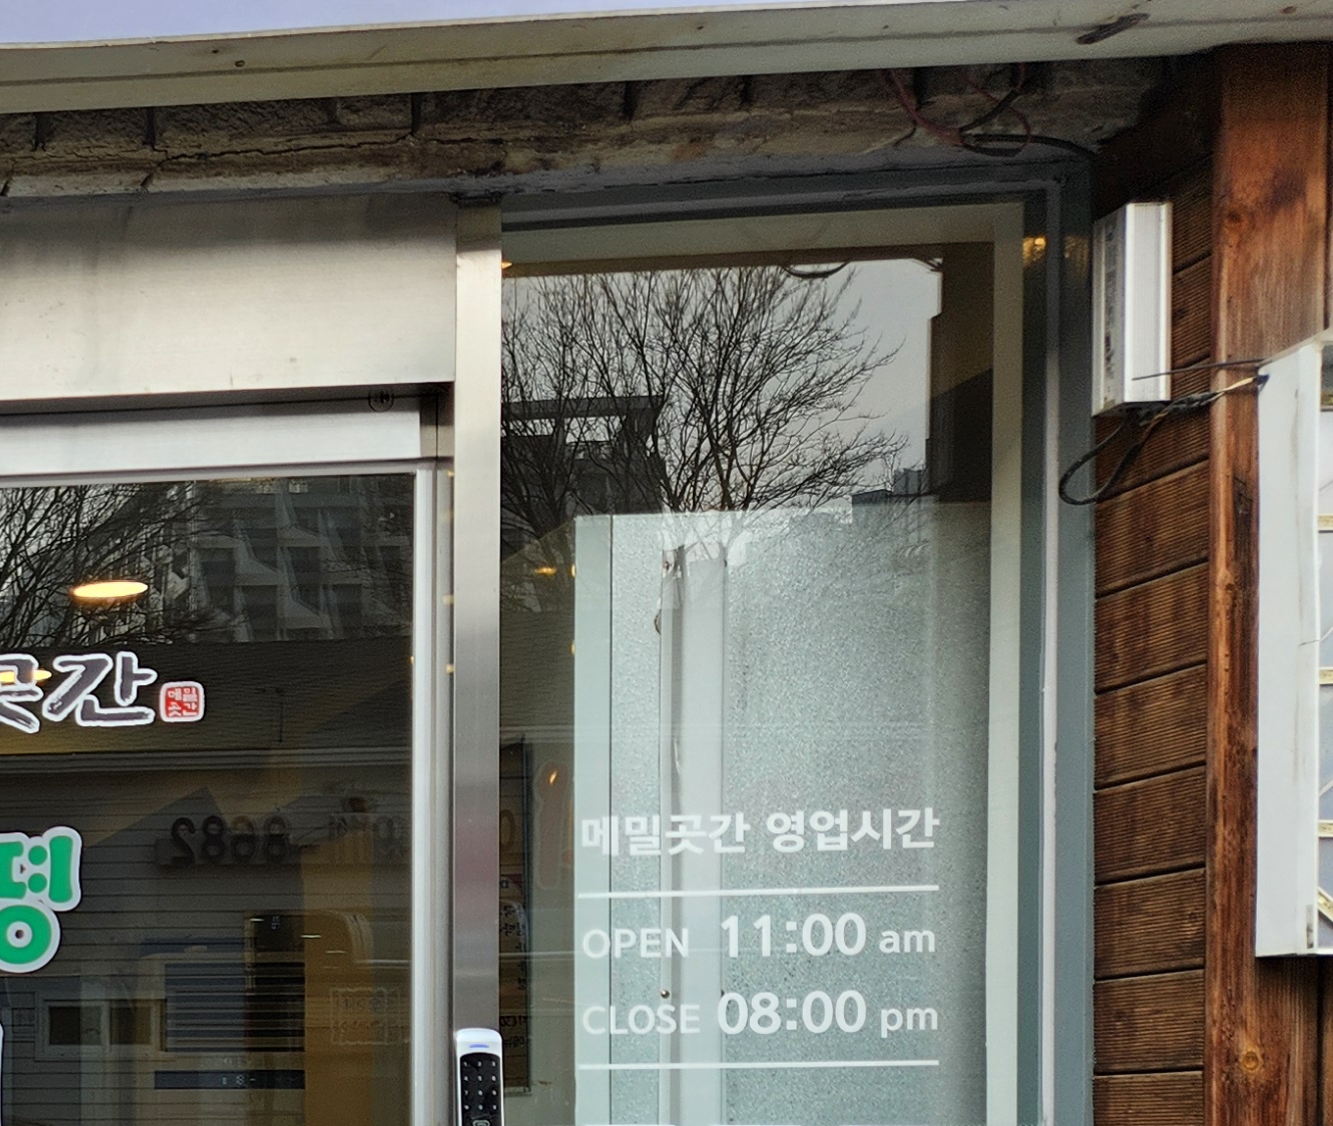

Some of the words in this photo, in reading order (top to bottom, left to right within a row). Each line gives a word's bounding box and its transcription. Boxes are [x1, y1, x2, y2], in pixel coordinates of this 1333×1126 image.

[582, 815, 750, 857] 메밀곳간
[766, 807, 939, 851] 영업시간
[583, 928, 689, 958] OPEN
[720, 913, 866, 959] 11:00
[879, 924, 936, 955] am
[582, 1004, 700, 1035] CLOSE
[718, 990, 866, 1035] 08:00
[881, 1004, 938, 1038] pm
